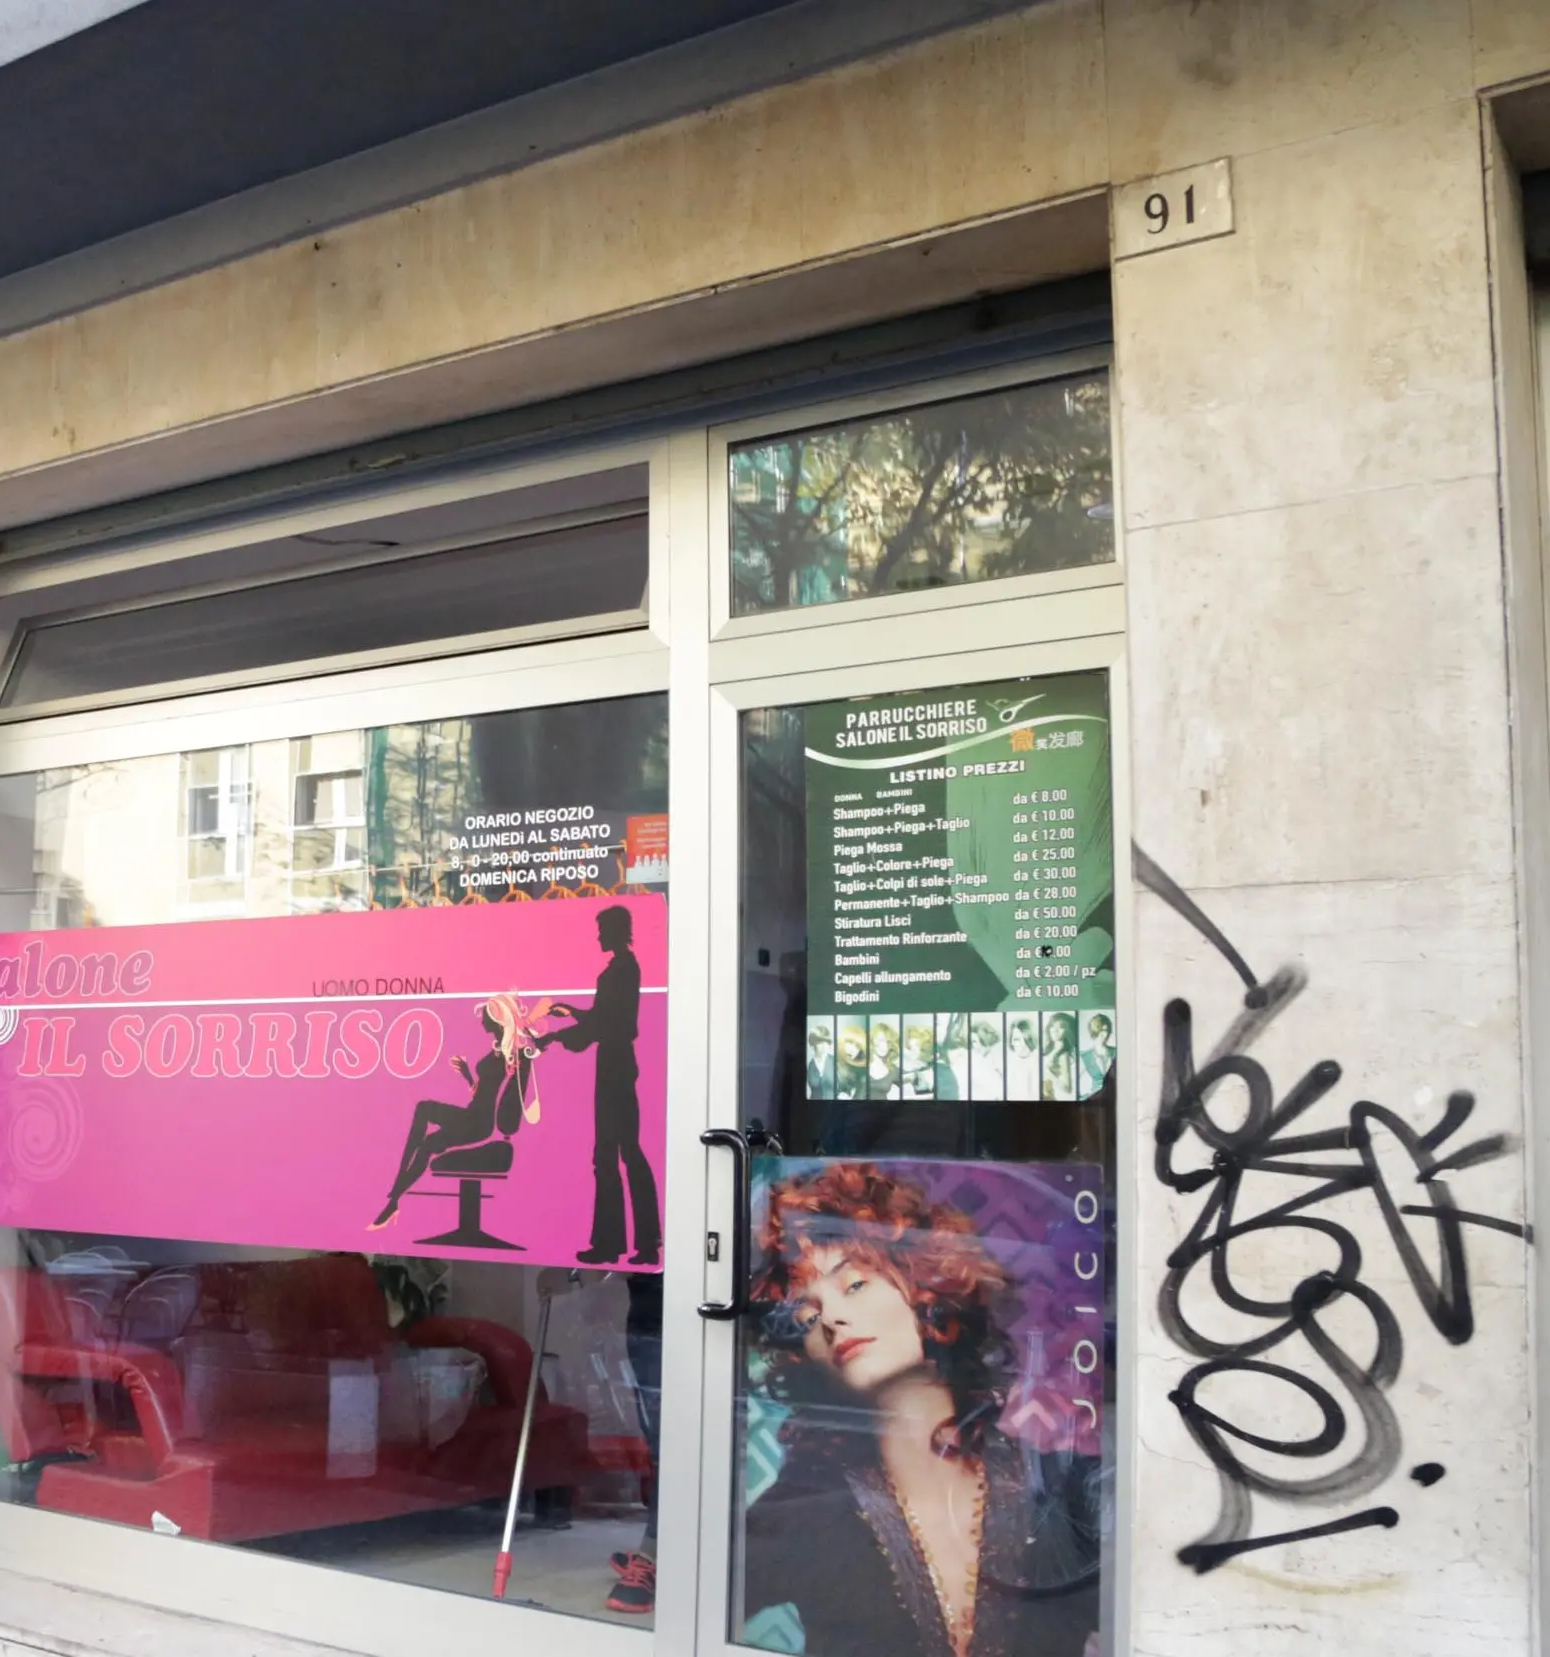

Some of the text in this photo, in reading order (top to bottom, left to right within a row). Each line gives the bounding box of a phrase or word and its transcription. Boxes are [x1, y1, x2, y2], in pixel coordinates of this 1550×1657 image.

[1144, 184, 1194, 234] 91
[846, 699, 977, 729] PARRUCCHIERE
[836, 717, 987, 748] SALONE IL SORRISO
[889, 760, 1025, 783] LISTINO PREZZI
[834, 788, 913, 802] DONNA BAMBINI
[1013, 789, 1067, 804] da € 8.00
[465, 806, 594, 830] ORARIO NEGOZIO
[833, 802, 926, 820] Shampoo+Piega
[1013, 807, 1075, 824] da € 10.00
[833, 817, 970, 838] Shampoo+Piega+Taglio
[1013, 827, 1075, 843] da € 12.00
[450, 836, 469, 850] DA
[528, 829, 547, 844] AL
[550, 824, 610, 842] SABATO
[491, 851, 530, 867] 20,00
[532, 846, 608, 863] continuato
[834, 841, 903, 858] Piega Mossa
[1013, 846, 1075, 862] da € 25.00
[834, 856, 954, 876] Taglio+Colore+Piega
[1014, 870, 1028, 881] da
[1033, 868, 1039, 880] €
[460, 864, 598, 887] DOMENICA RIPOSO
[834, 872, 988, 894] Taglio+Colpi di sole+Piega
[834, 892, 1010, 911] Permanente+Taglio+Shampoo
[1015, 886, 1077, 900] da € 28.00
[1014, 906, 1076, 920] da € 50.00
[834, 914, 911, 930] Stiratura Lisci
[834, 931, 968, 948] Trattamento Rinforzante
[1015, 925, 1077, 940] da € 20.00
[834, 952, 880, 966] Bambini
[1016, 947, 1031, 959] da
[834, 970, 952, 986] Capelli allungamento
[1015, 967, 1030, 978] da
[1034, 965, 1041, 977] €
[1082, 966, 1096, 979] pz
[312, 976, 444, 997] UOMO DONNA
[1016, 984, 1079, 998] da € 10.00
[834, 990, 880, 1005] Bigodini
[17, 1008, 443, 1079] IL SORRISO
[1073, 1190, 1098, 1429] JOICO
